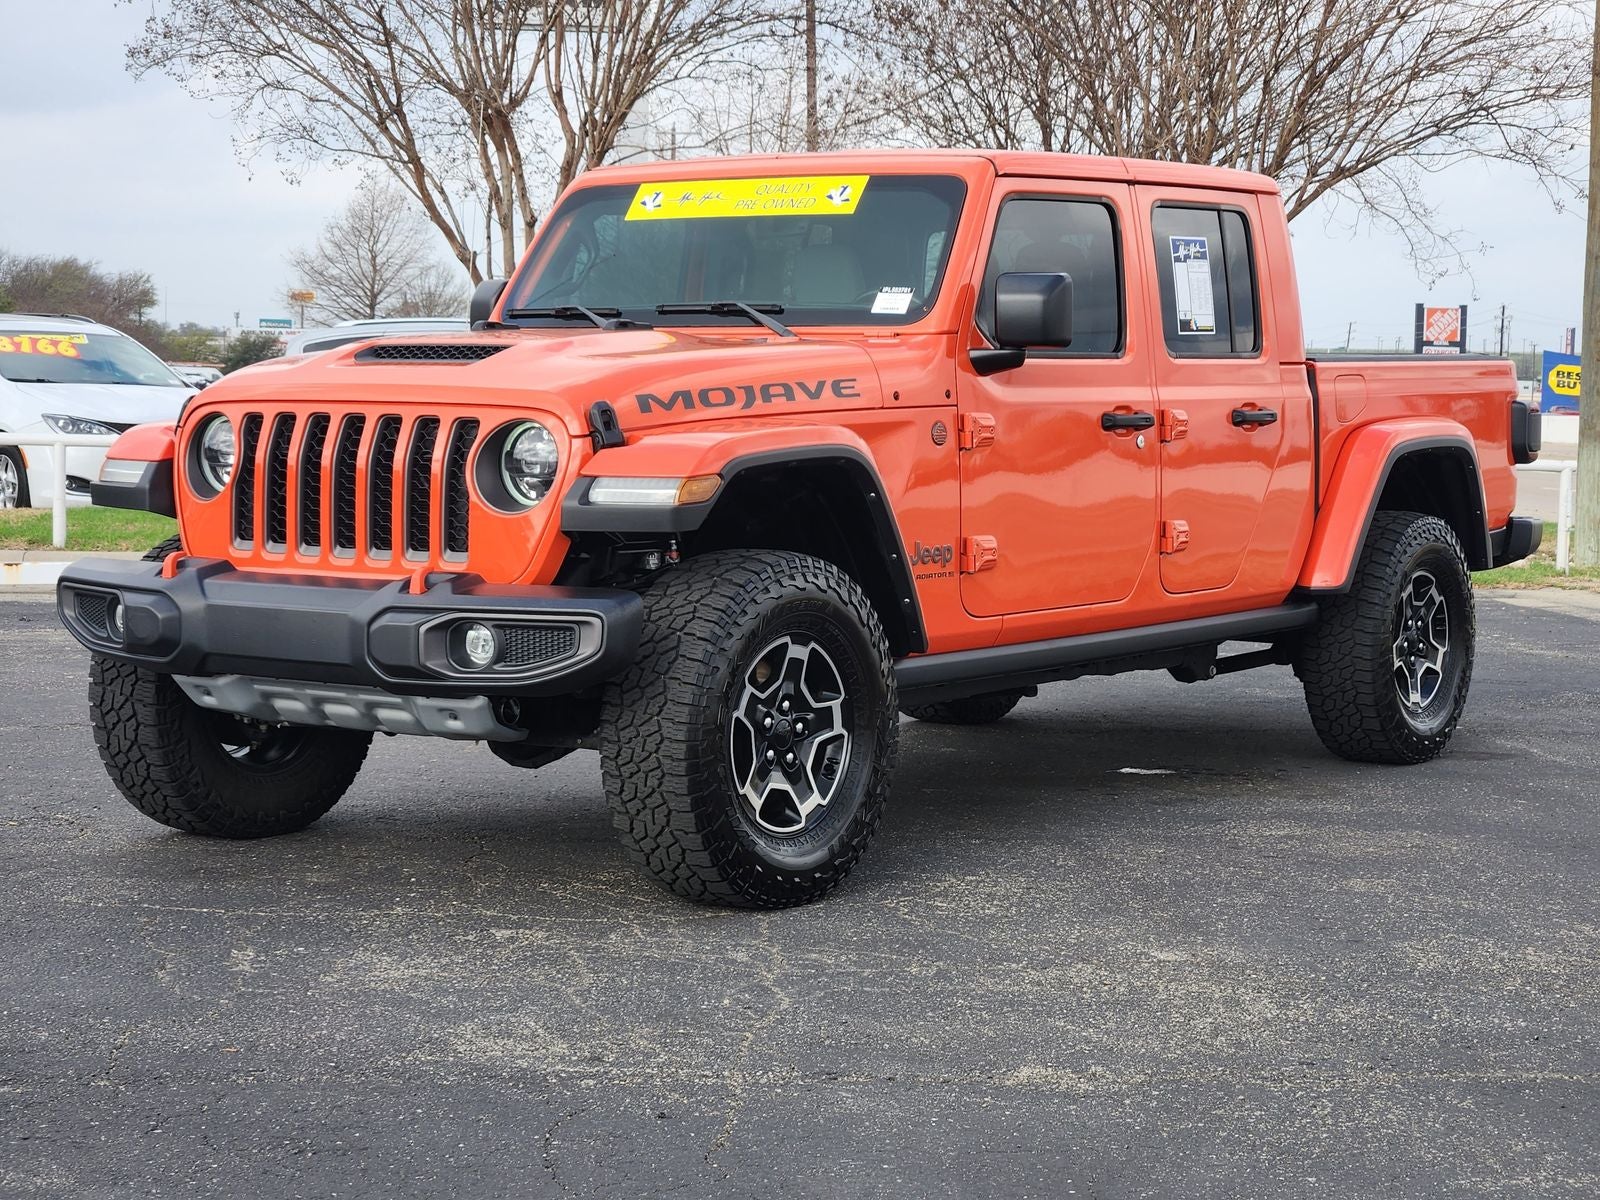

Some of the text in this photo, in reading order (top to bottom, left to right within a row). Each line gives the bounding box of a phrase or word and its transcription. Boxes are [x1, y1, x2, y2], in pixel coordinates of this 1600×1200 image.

[755, 183, 816, 196] QUALITY
[1556, 370, 1581, 381] BES
[1556, 379, 1581, 390] BU
[635, 378, 861, 414] MOJAVE
[910, 540, 953, 568] Jeep
[916, 572, 947, 580] ADIATOR
